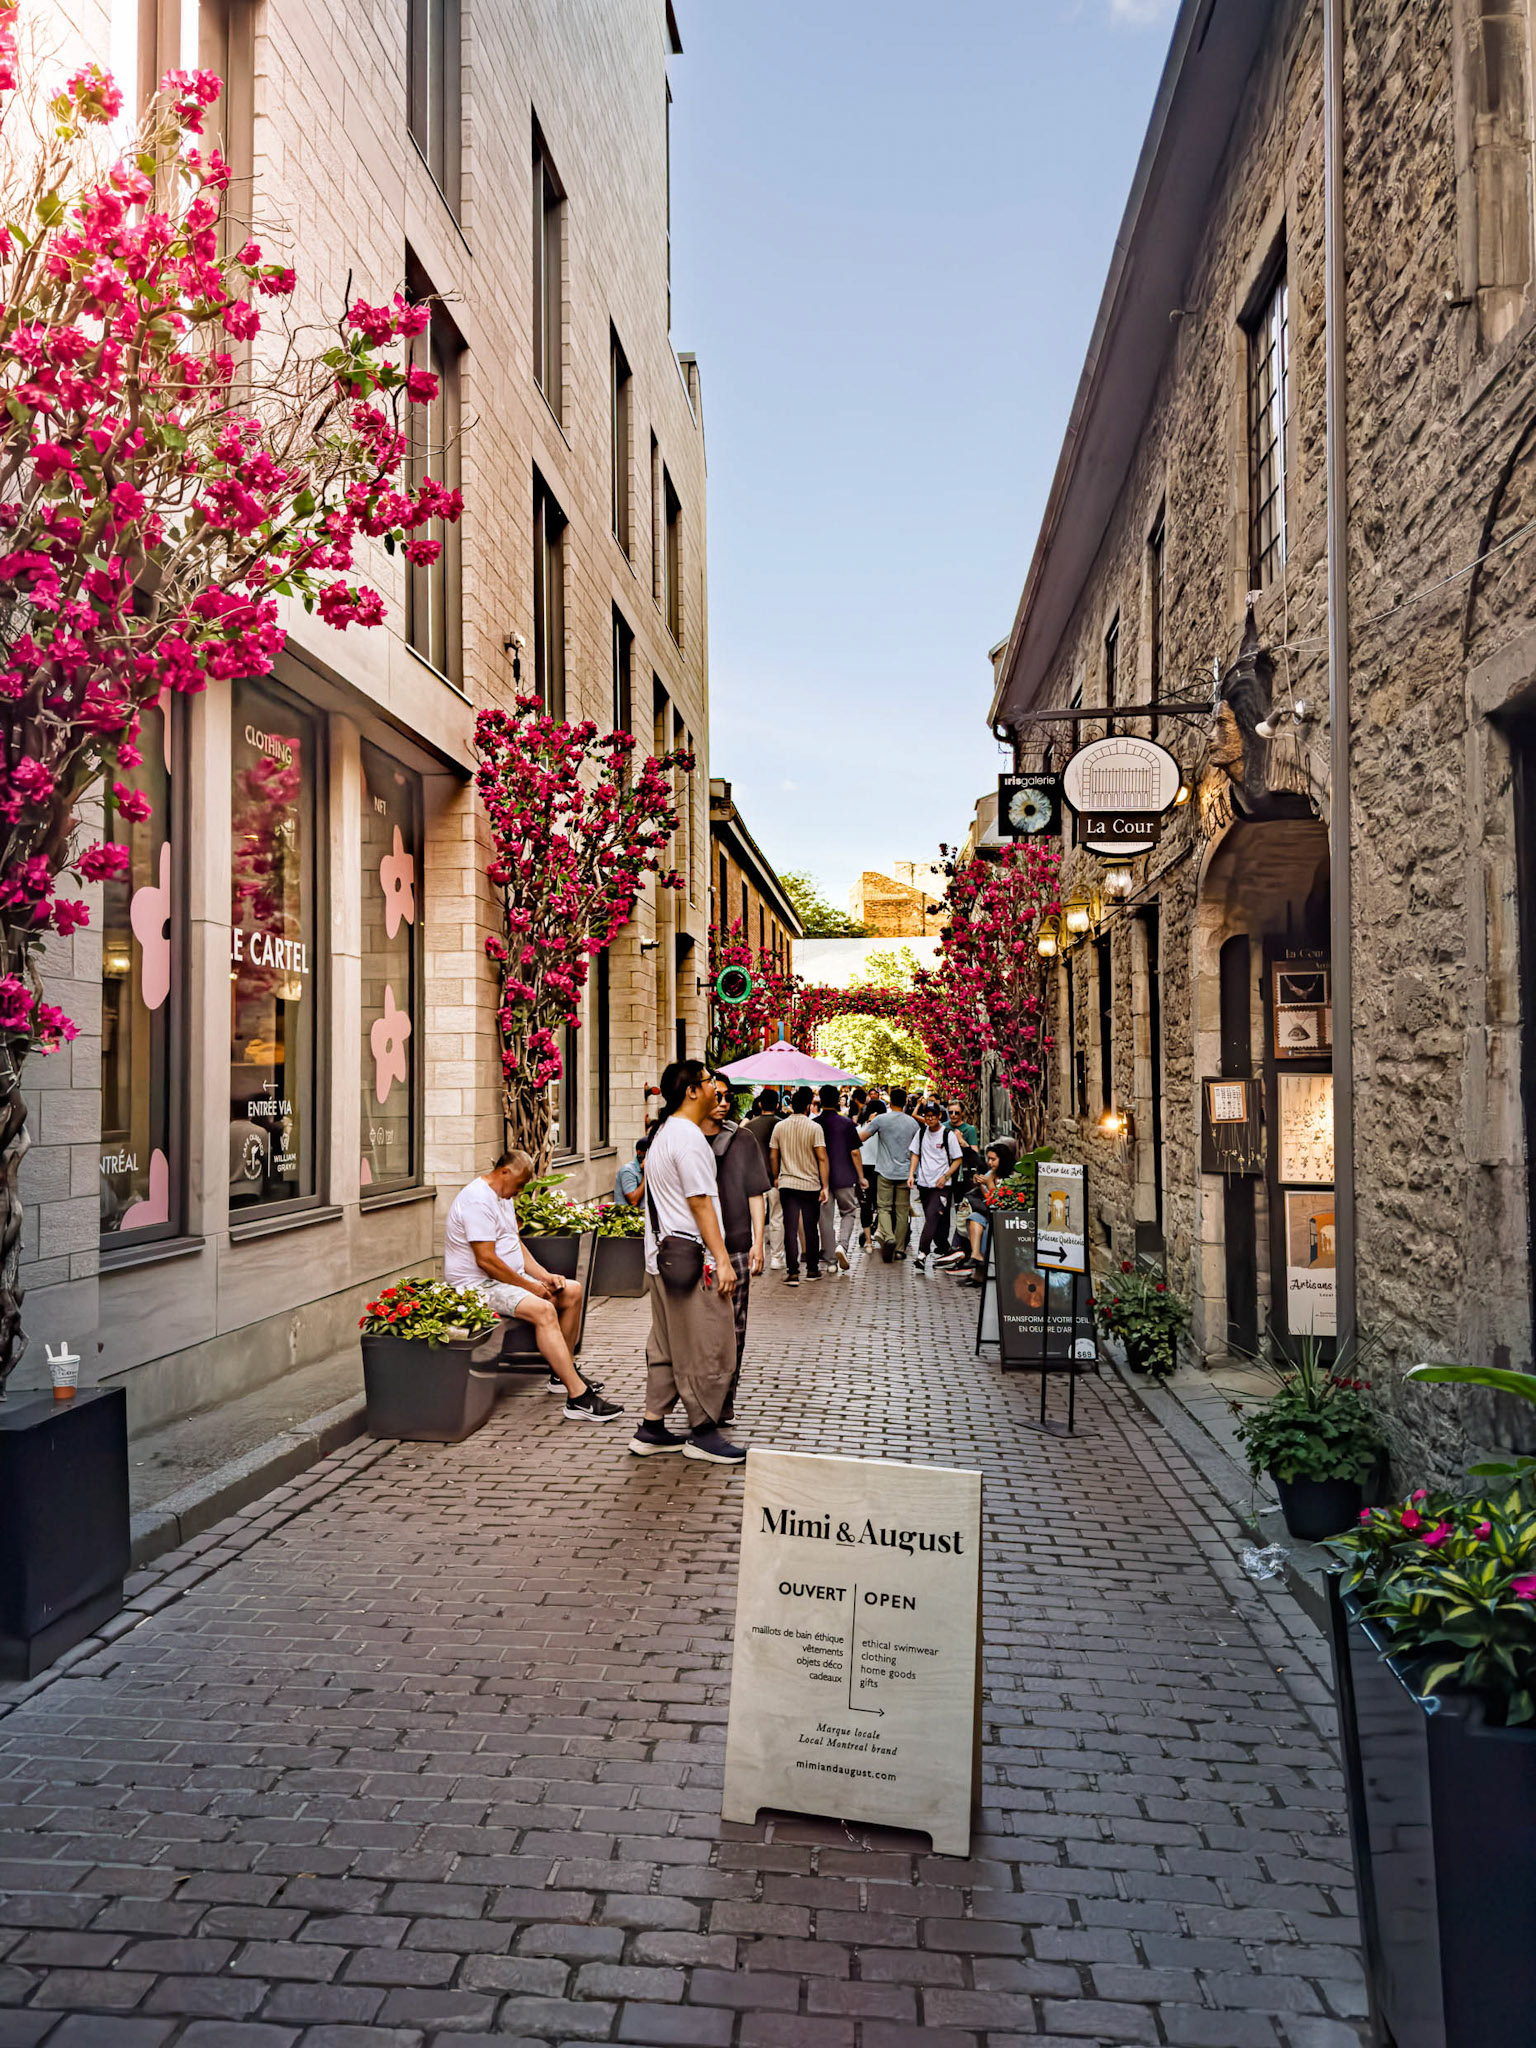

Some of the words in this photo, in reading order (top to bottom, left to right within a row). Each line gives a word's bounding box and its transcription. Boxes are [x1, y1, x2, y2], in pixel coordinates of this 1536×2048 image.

[245, 725, 292, 765] CLOTHING
[1087, 819, 1106, 834] La
[1112, 819, 1154, 834] Cour
[250, 932, 309, 974] CARTEL
[247, 1096, 278, 1117] ENTRÉE
[279, 1100, 292, 1115] VIA
[273, 1153, 297, 1163] WILLIAM
[1290, 1279, 1332, 1290] Artisans
[1003, 1315, 1051, 1324] TRANSFORMZ
[1019, 1325, 1028, 1333] EN
[1029, 1325, 1055, 1333] OEURE
[760, 1506, 830, 1540] Mimi
[836, 1521, 855, 1547] &
[857, 1518, 964, 1557] August
[778, 1581, 847, 1602] OUVERT
[864, 1591, 916, 1611] OPEN
[751, 1625, 782, 1637] maillots
[783, 1627, 794, 1638] de
[795, 1629, 812, 1641] bain
[814, 1632, 844, 1645] éthique
[802, 1644, 844, 1657] vêtements
[861, 1639, 891, 1651] ethical
[893, 1644, 939, 1657] swimwear
[796, 1657, 821, 1669] objets
[822, 1658, 843, 1670] déco
[861, 1652, 897, 1667] clothing
[809, 1671, 843, 1683] cadeaux
[860, 1665, 886, 1677] home
[888, 1668, 917, 1680] goods
[859, 1677, 878, 1689] gifts
[815, 1722, 851, 1737] Marque
[854, 1727, 881, 1740] locale
[798, 1733, 824, 1746] Local
[826, 1737, 869, 1752] Montreal
[871, 1744, 899, 1756] brand
[796, 1760, 897, 1782] mimiandaugust.com
